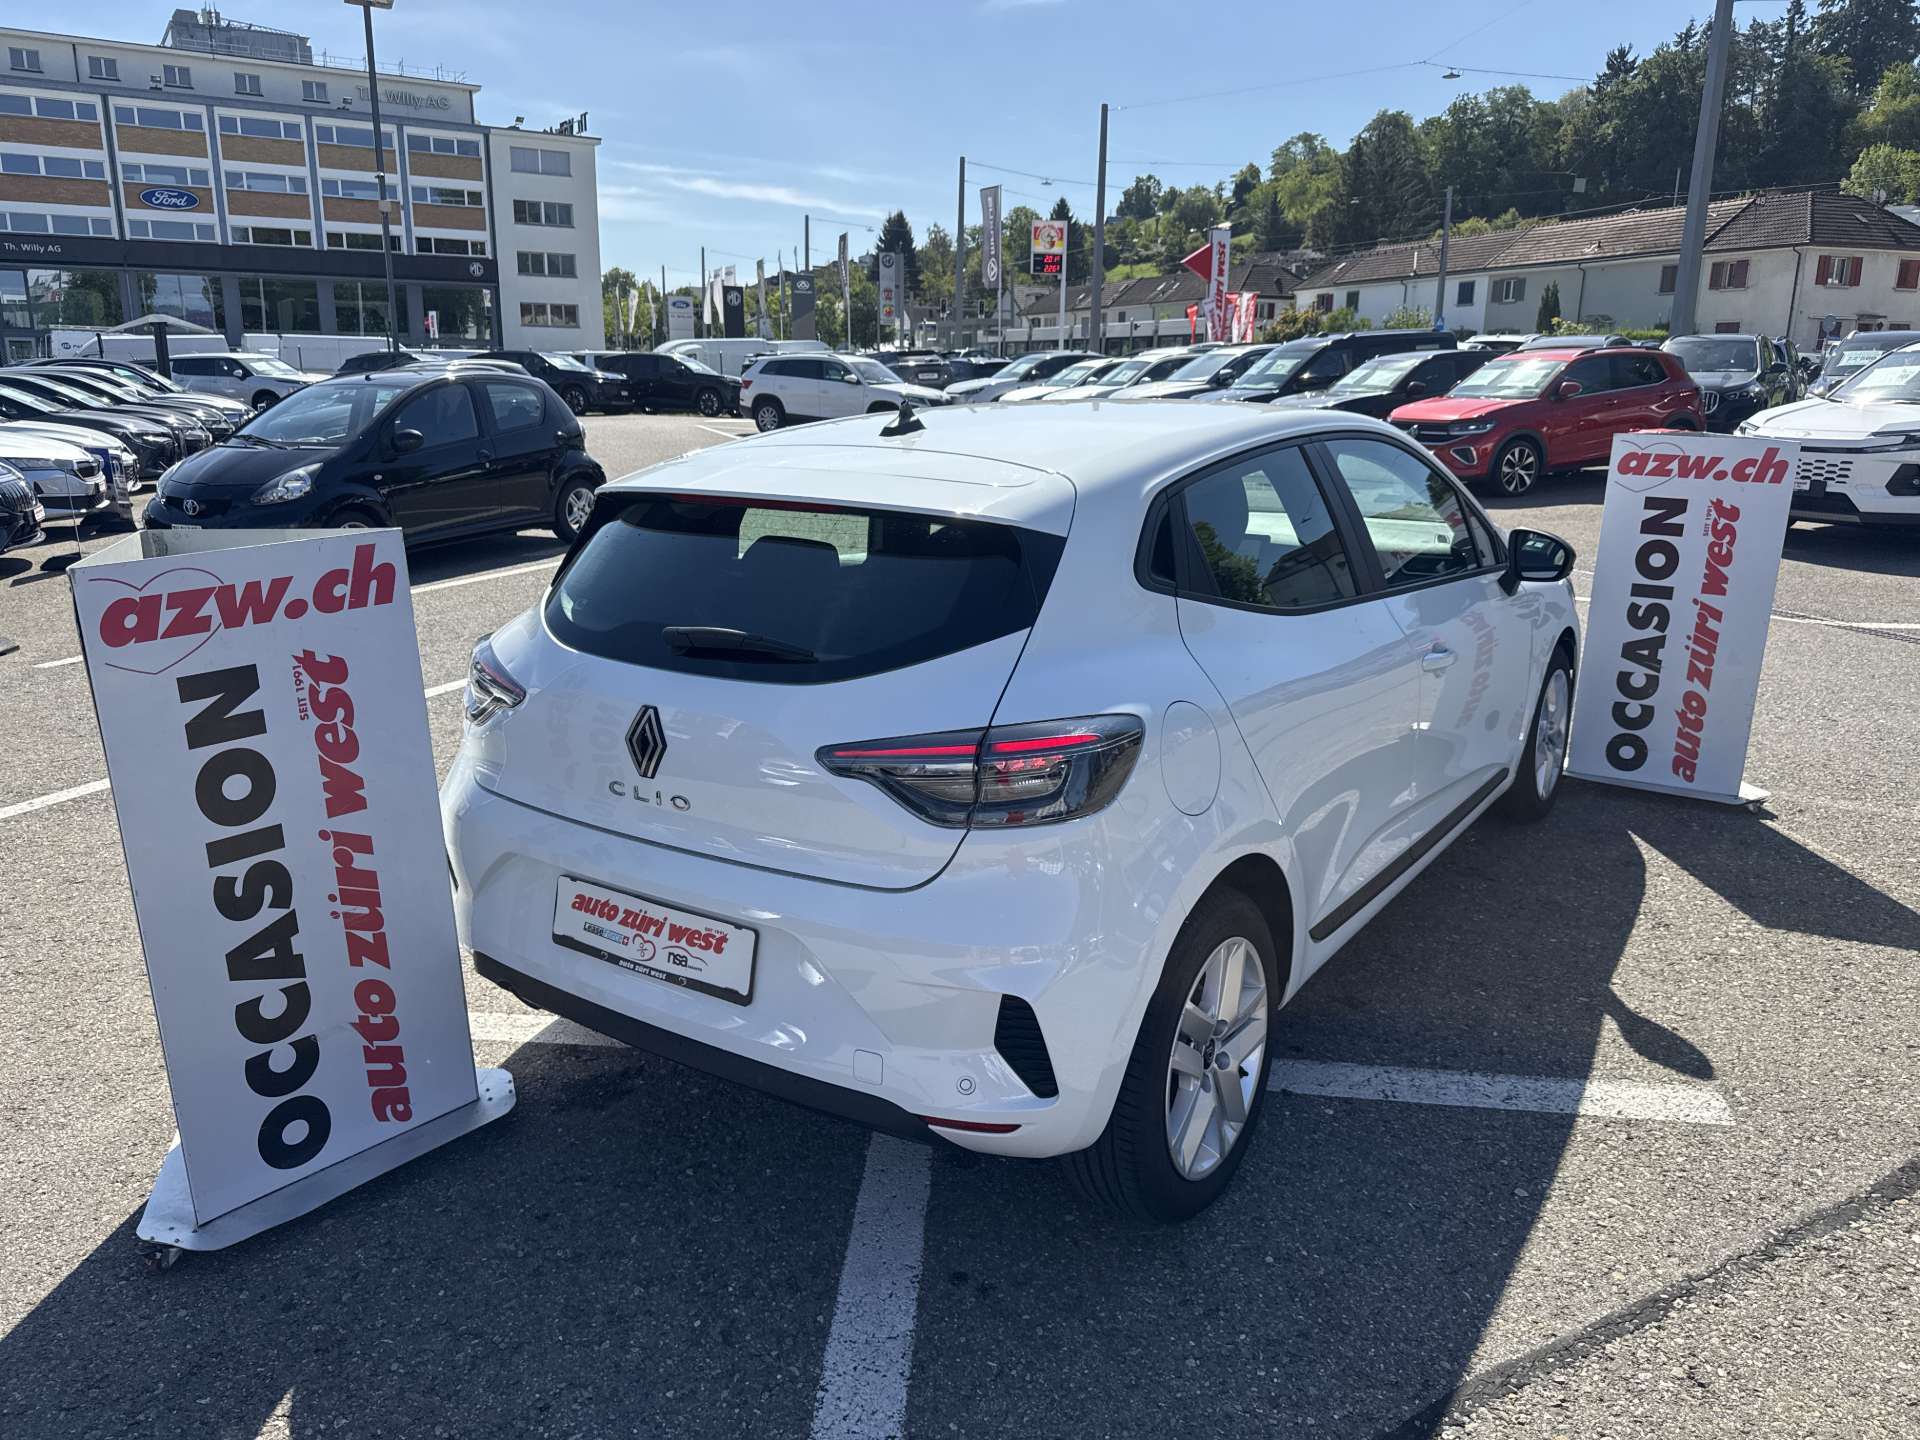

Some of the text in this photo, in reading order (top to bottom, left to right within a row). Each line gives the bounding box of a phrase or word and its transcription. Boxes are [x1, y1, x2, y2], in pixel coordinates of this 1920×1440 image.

[384, 88, 424, 110] Willy
[426, 93, 449, 110] AG
[152, 190, 188, 206] Ford
[20, 243, 45, 254] Willy
[47, 244, 62, 253] AG
[1617, 447, 1790, 485] azw.ch
[1702, 504, 1714, 537] SEIT 1991
[99, 543, 397, 648] azw.ch
[1606, 496, 1689, 772] OCCASION
[1672, 497, 1741, 784] auto züri west
[292, 663, 310, 721] SEIT 1991
[608, 780, 691, 812] CLIO
[291, 648, 414, 1124] auto züri west
[176, 663, 332, 1171] OCCASION
[571, 893, 729, 955] auto züri west
[618, 959, 667, 980] auto züri west
[667, 951, 689, 969] nsa
